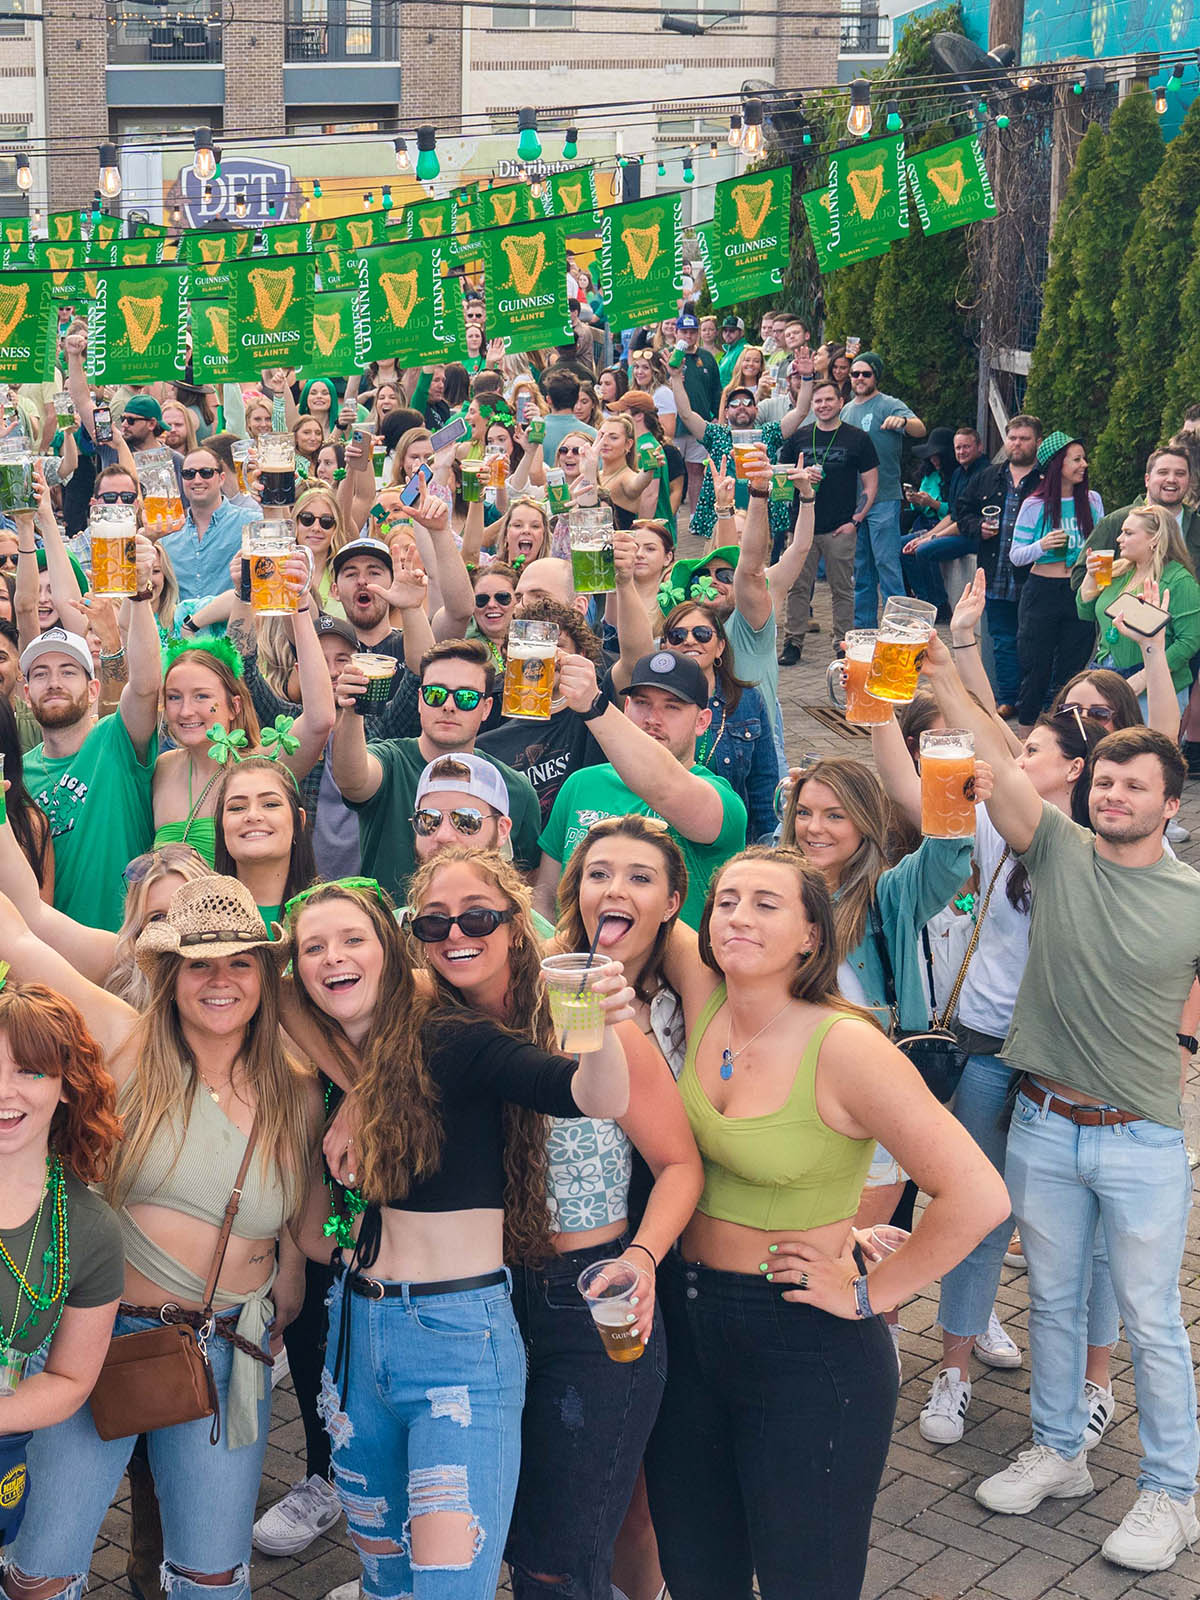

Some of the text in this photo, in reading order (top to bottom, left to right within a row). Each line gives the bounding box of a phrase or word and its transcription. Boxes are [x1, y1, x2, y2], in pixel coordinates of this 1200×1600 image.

[197, 173, 277, 216] DET
[896, 142, 910, 229] GUINNESS
[970, 139, 997, 209] GUINNESS
[826, 160, 841, 252] GUINNESS
[907, 163, 932, 231] GUINNESS
[602, 216, 613, 306] GUINNESS
[672, 202, 684, 291] GUINNESS
[724, 236, 778, 257] GUINNESS
[735, 253, 768, 267] SLÁINTE
[52, 284, 77, 295] INNESS
[195, 275, 231, 287] GUINNESS
[432, 247, 445, 342] GUINNESS
[174, 275, 189, 371] GUINNESS
[358, 258, 373, 355] GUINNESS
[498, 293, 556, 313] GUINNESS
[510, 311, 545, 324] SLÁINTE
[95, 279, 108, 376] GUINNESS
[241, 330, 301, 347] GUINNESS
[203, 354, 229, 366] GUIN
[253, 347, 289, 358] SLÁINTE
[611, 1331, 630, 1340] GUIN
